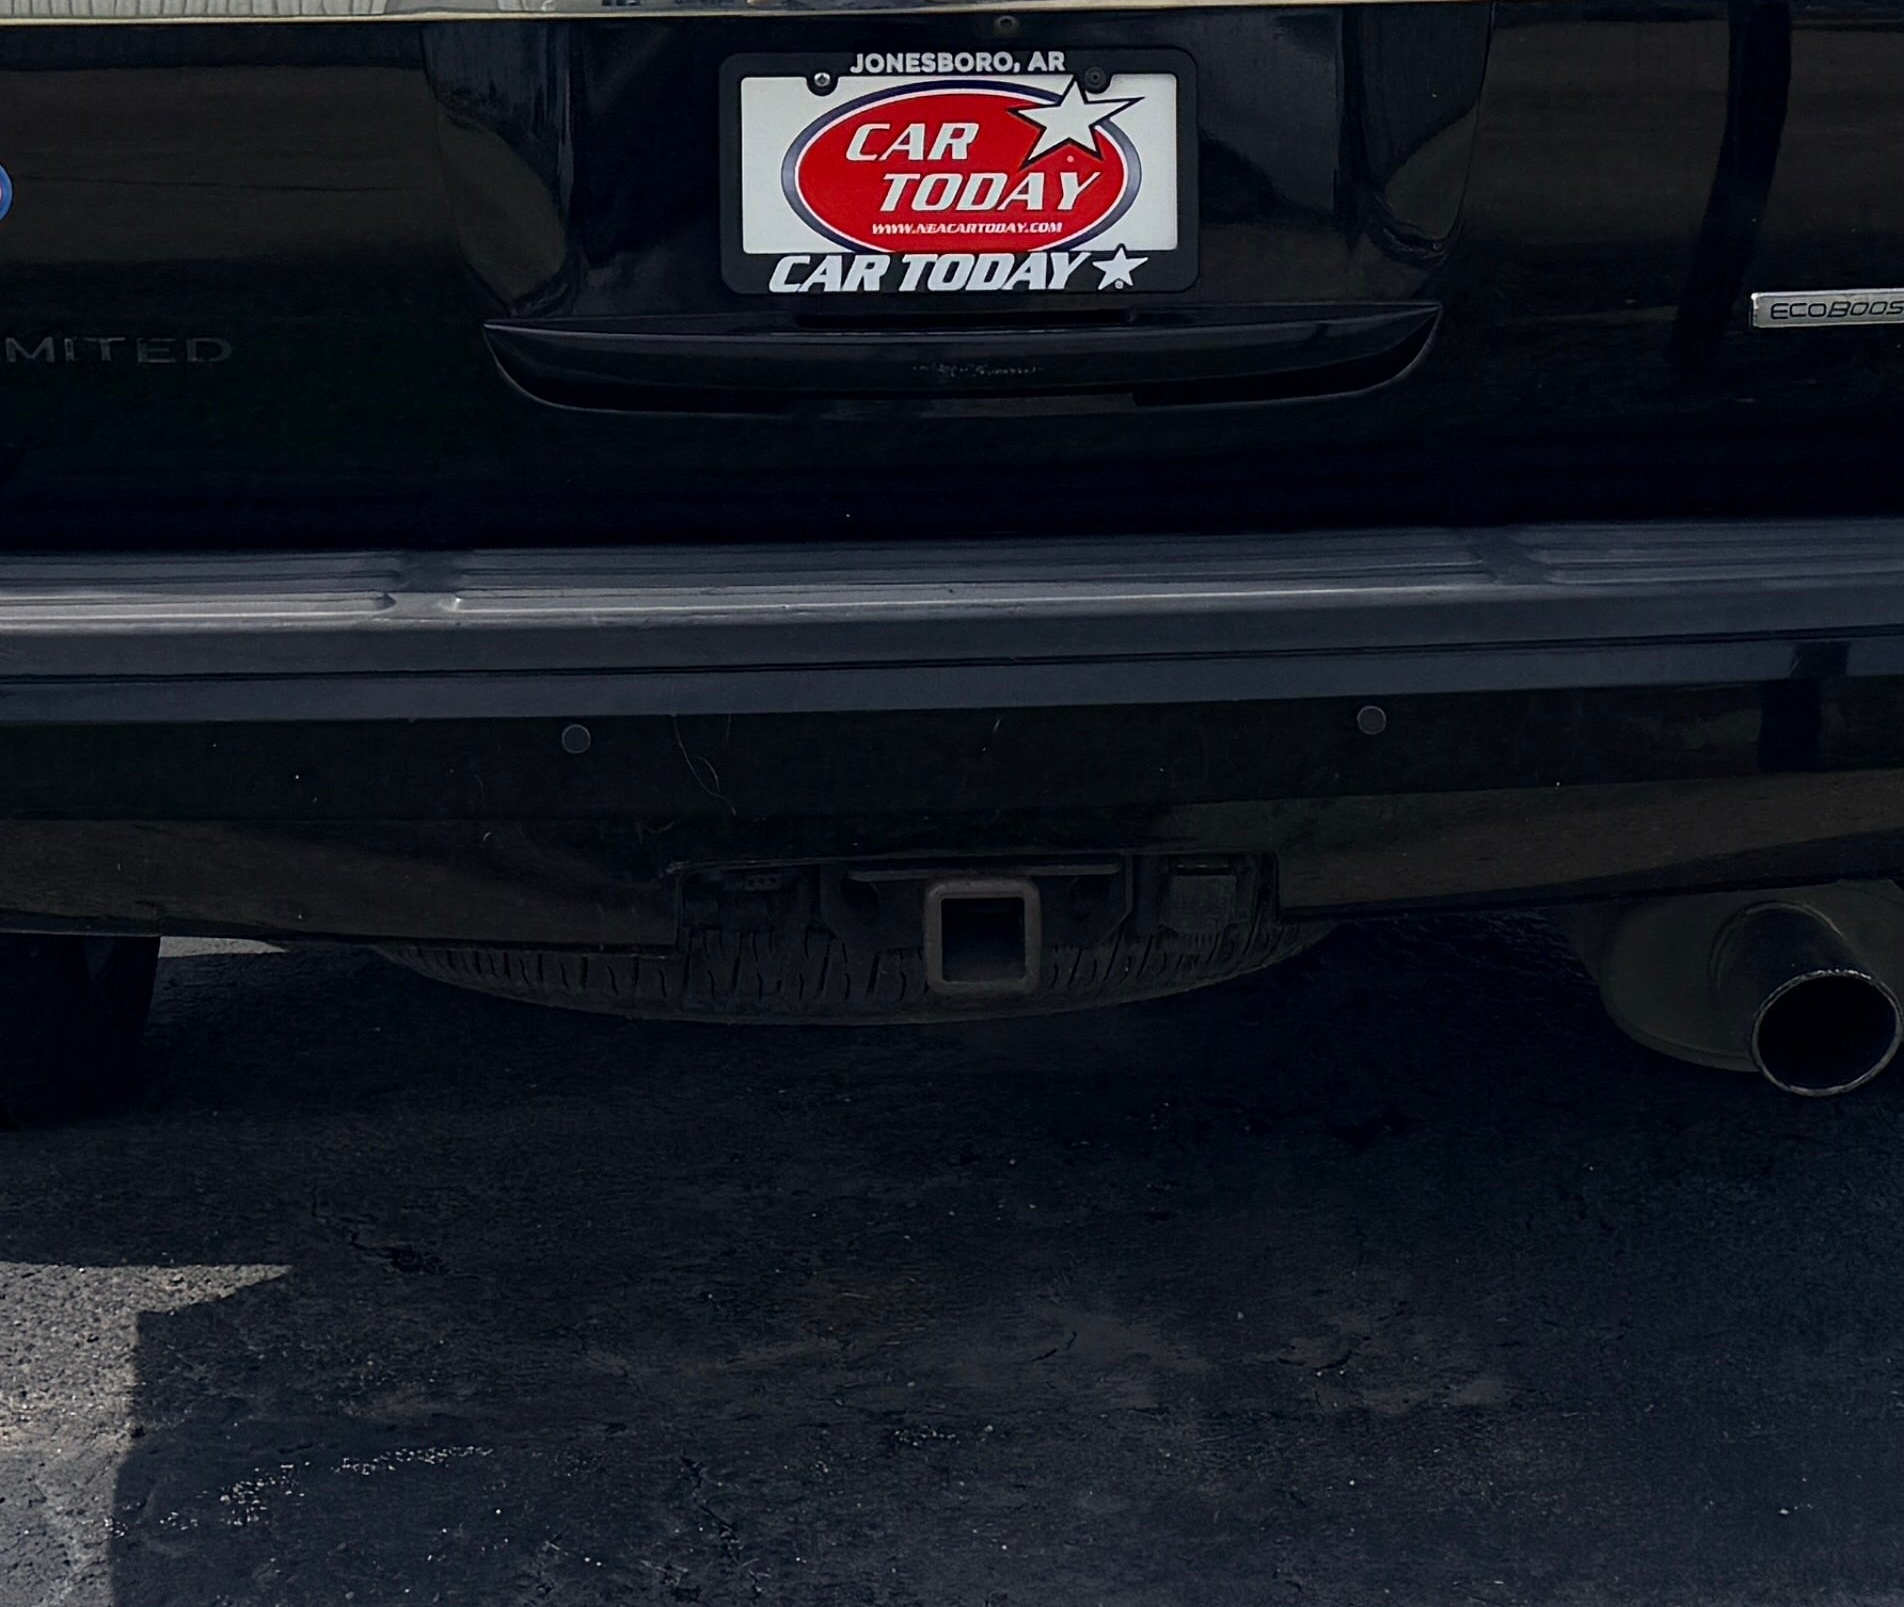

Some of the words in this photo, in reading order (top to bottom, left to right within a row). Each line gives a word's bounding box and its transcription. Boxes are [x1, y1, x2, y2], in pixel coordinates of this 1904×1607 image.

[849, 52, 1020, 75] JONESBORO,
[1027, 51, 1066, 72] AR
[845, 122, 980, 161] CAR
[879, 171, 1101, 212] TODAY
[871, 221, 1063, 235] WWW.NEACARTODAY.COM
[768, 254, 891, 294] CAR
[899, 252, 1092, 292] TODAY
